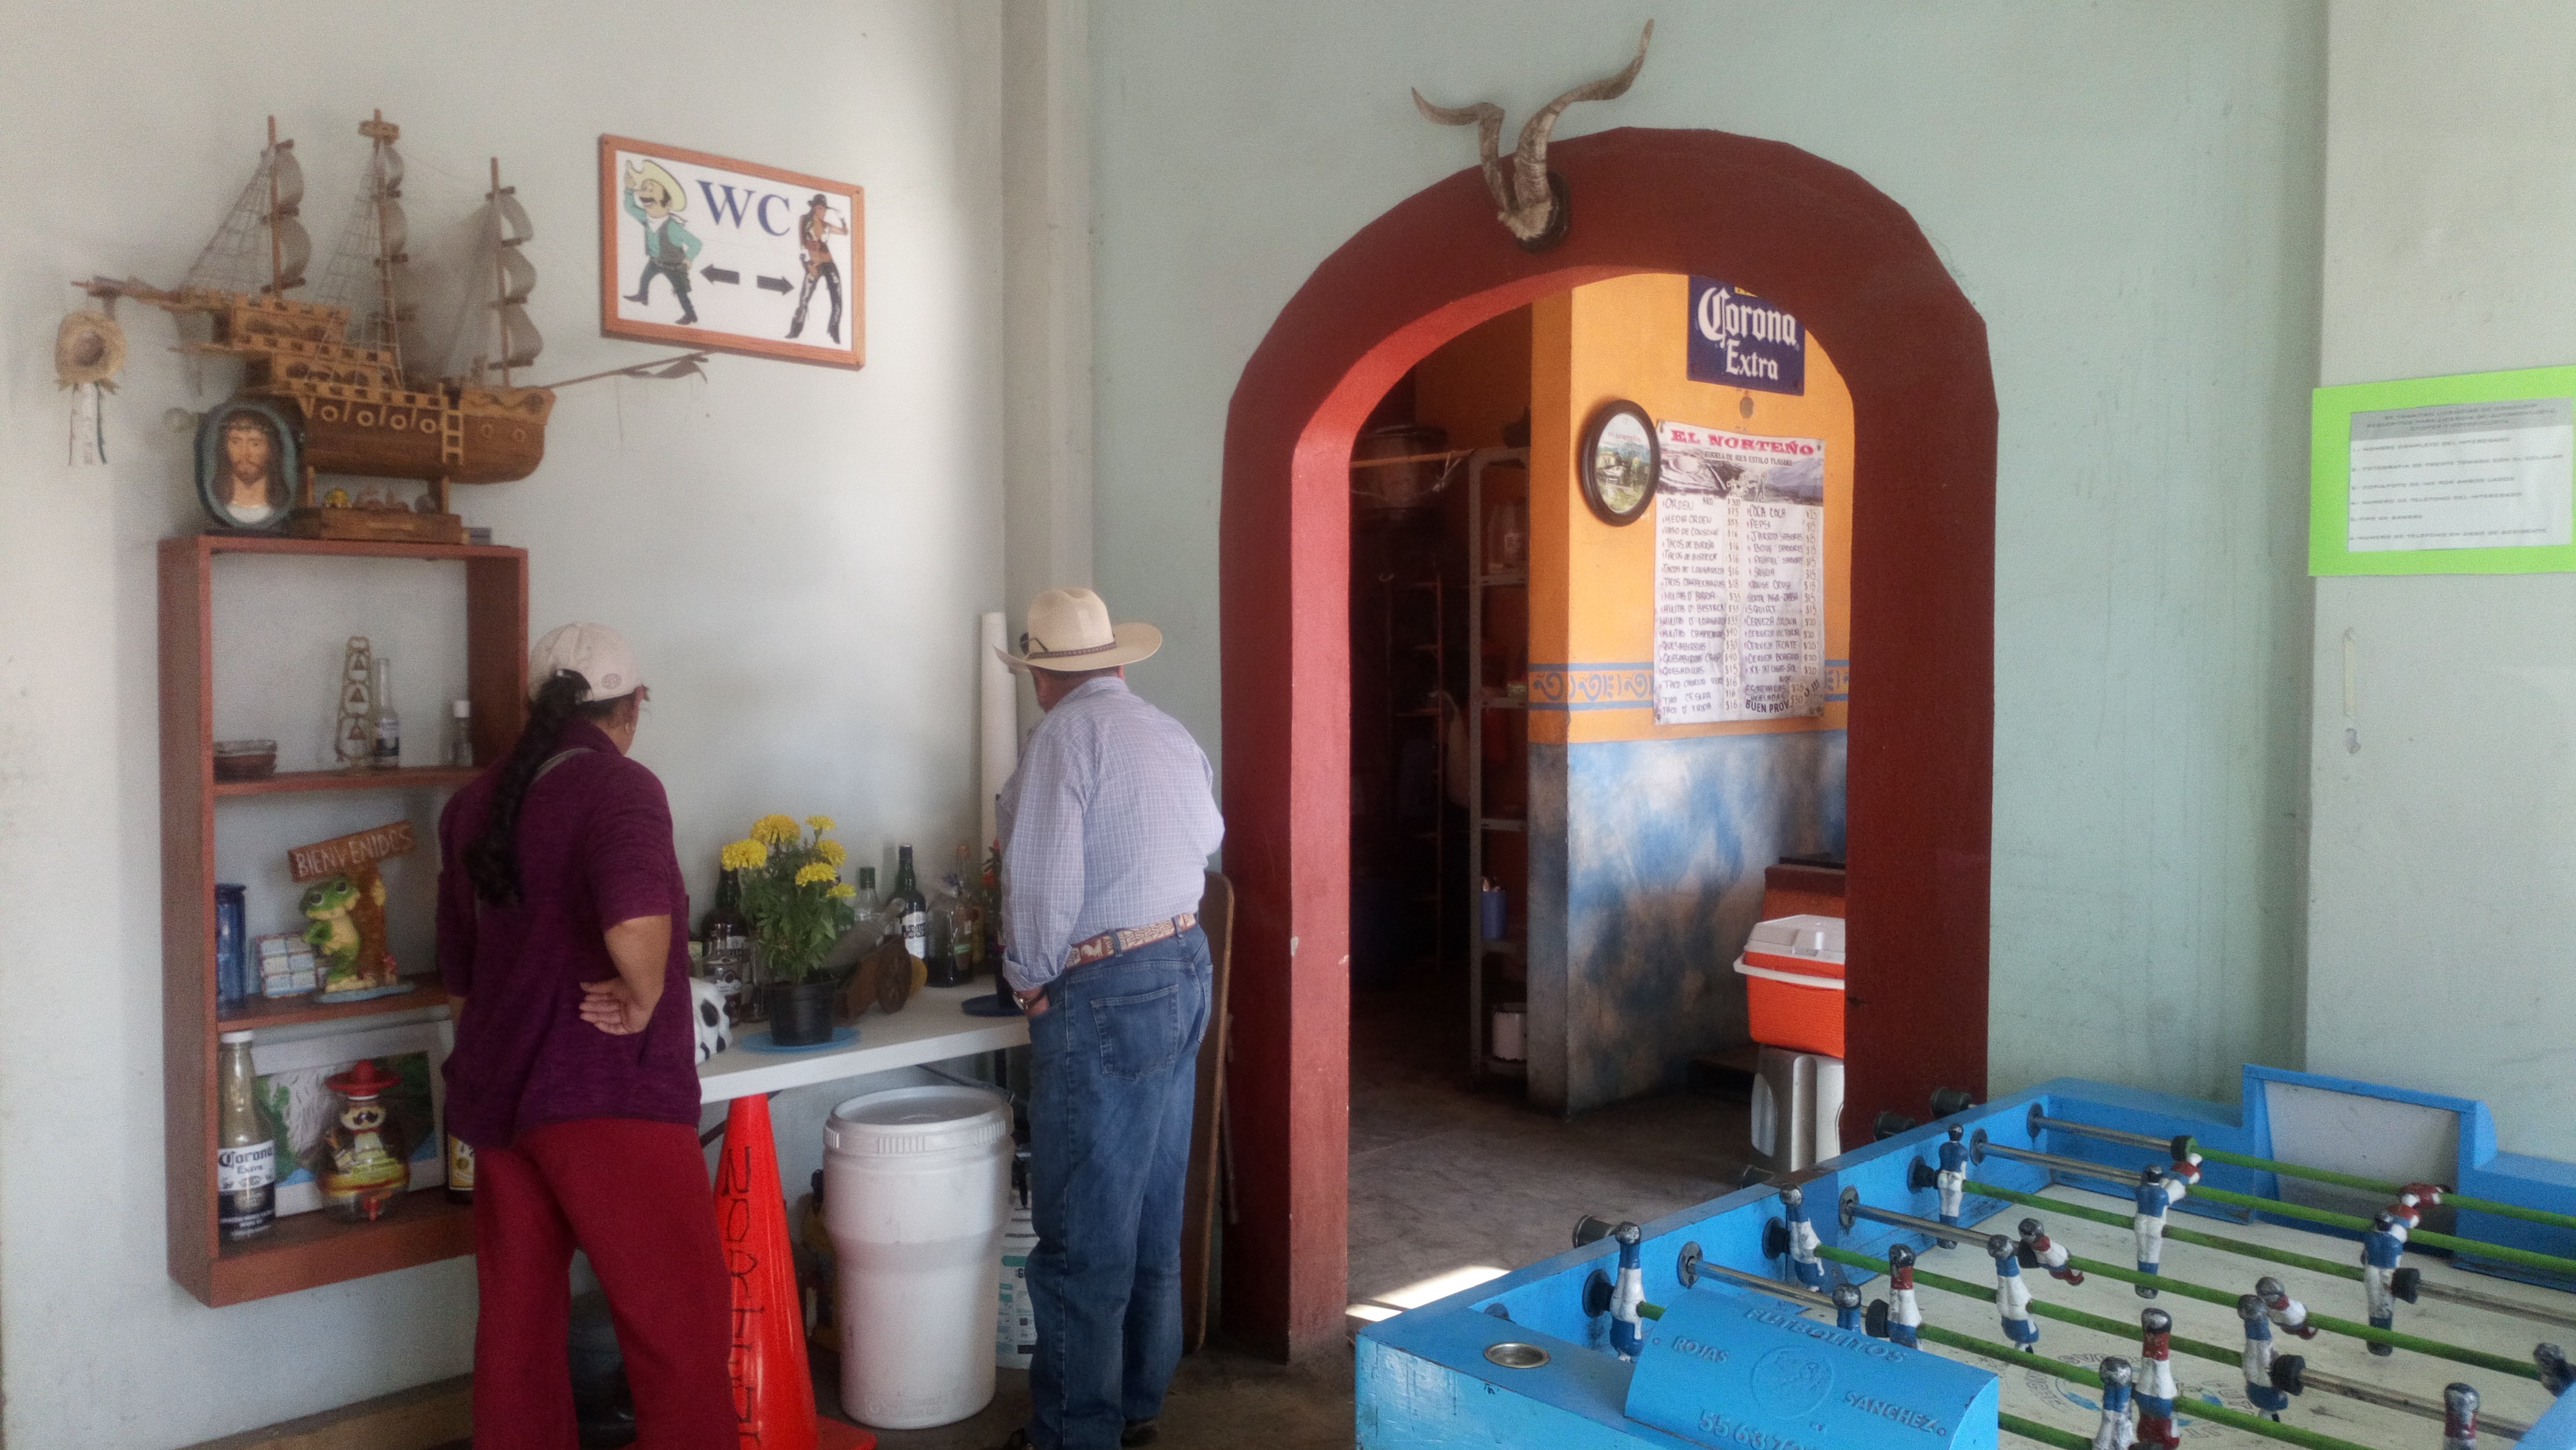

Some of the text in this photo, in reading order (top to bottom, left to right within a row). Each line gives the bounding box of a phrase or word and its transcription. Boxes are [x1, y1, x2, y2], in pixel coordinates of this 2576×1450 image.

[697, 180, 791, 236] WC
[1698, 287, 1797, 348] Corona
[1725, 338, 1779, 381] Extra
[1670, 429, 1814, 456] EL NORTEÑO
[1704, 450, 1726, 460] BIRRIA
[1748, 456, 1769, 464] ESTILO
[1745, 699, 1767, 713] BUEN
[218, 1146, 272, 1169] Corona
[1672, 1335, 1729, 1364] ROJAS
